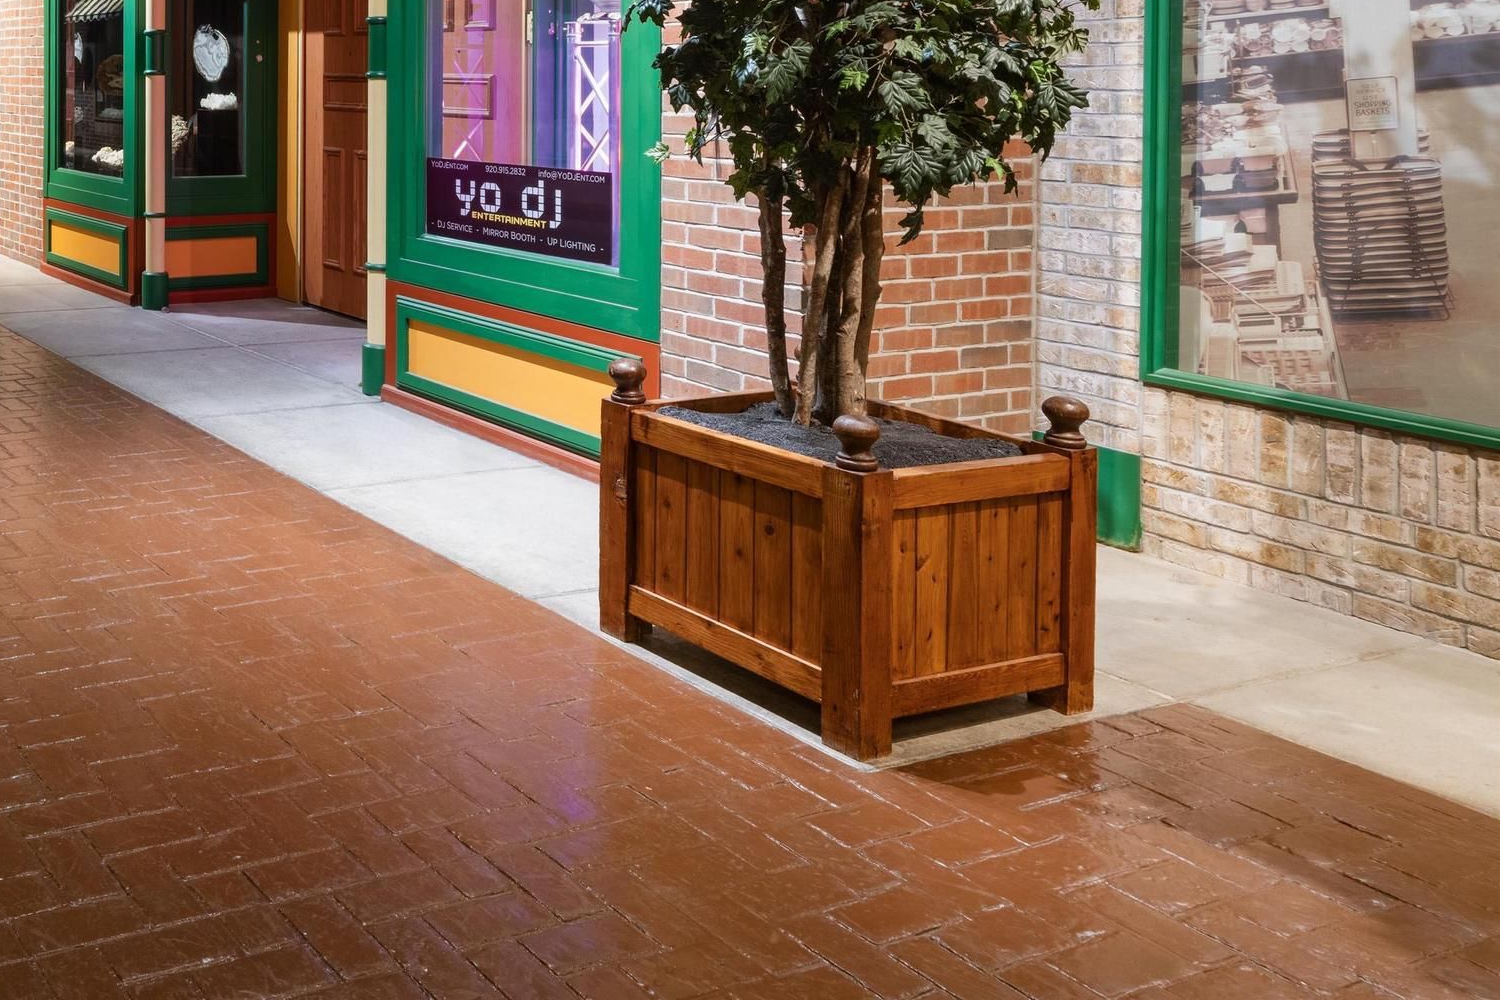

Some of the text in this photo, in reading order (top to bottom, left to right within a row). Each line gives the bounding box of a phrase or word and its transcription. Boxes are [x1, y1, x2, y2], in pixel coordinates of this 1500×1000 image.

[1354, 100, 1392, 109] SHOPPING
[1355, 106, 1390, 117] BASKETS
[485, 165, 526, 177] 920.915.2832
[455, 179, 501, 216] yo
[471, 210, 547, 229] ENTERTAINMENT
[437, 219, 596, 253] DJ SERVICE MIRROR BOOTH UP LIGHTING
